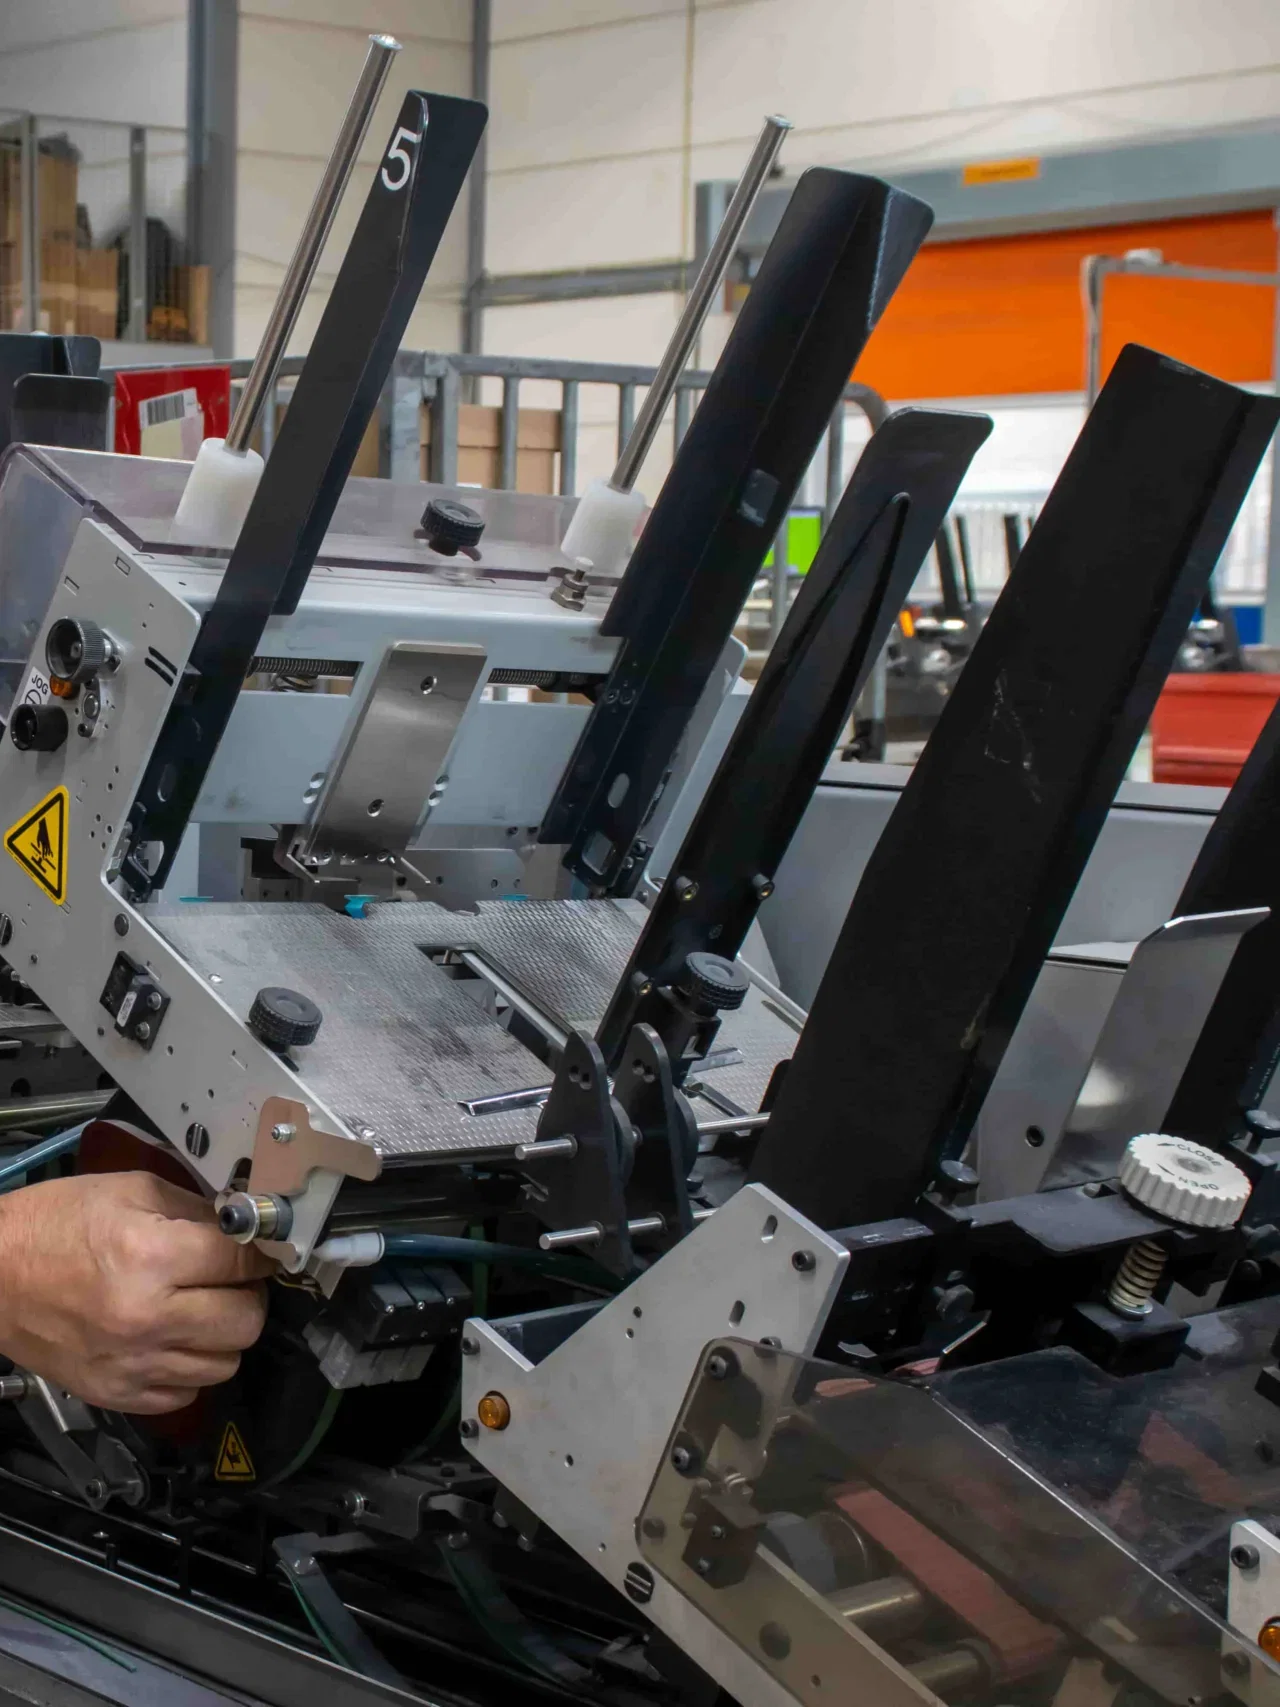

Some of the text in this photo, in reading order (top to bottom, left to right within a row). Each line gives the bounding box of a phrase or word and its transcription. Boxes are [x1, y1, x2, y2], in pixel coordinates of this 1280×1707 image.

[381, 126, 422, 191] 5
[31, 674, 49, 695] JOG
[1177, 1143, 1223, 1167] CLOSE
[1178, 1175, 1220, 1191] OPEN
